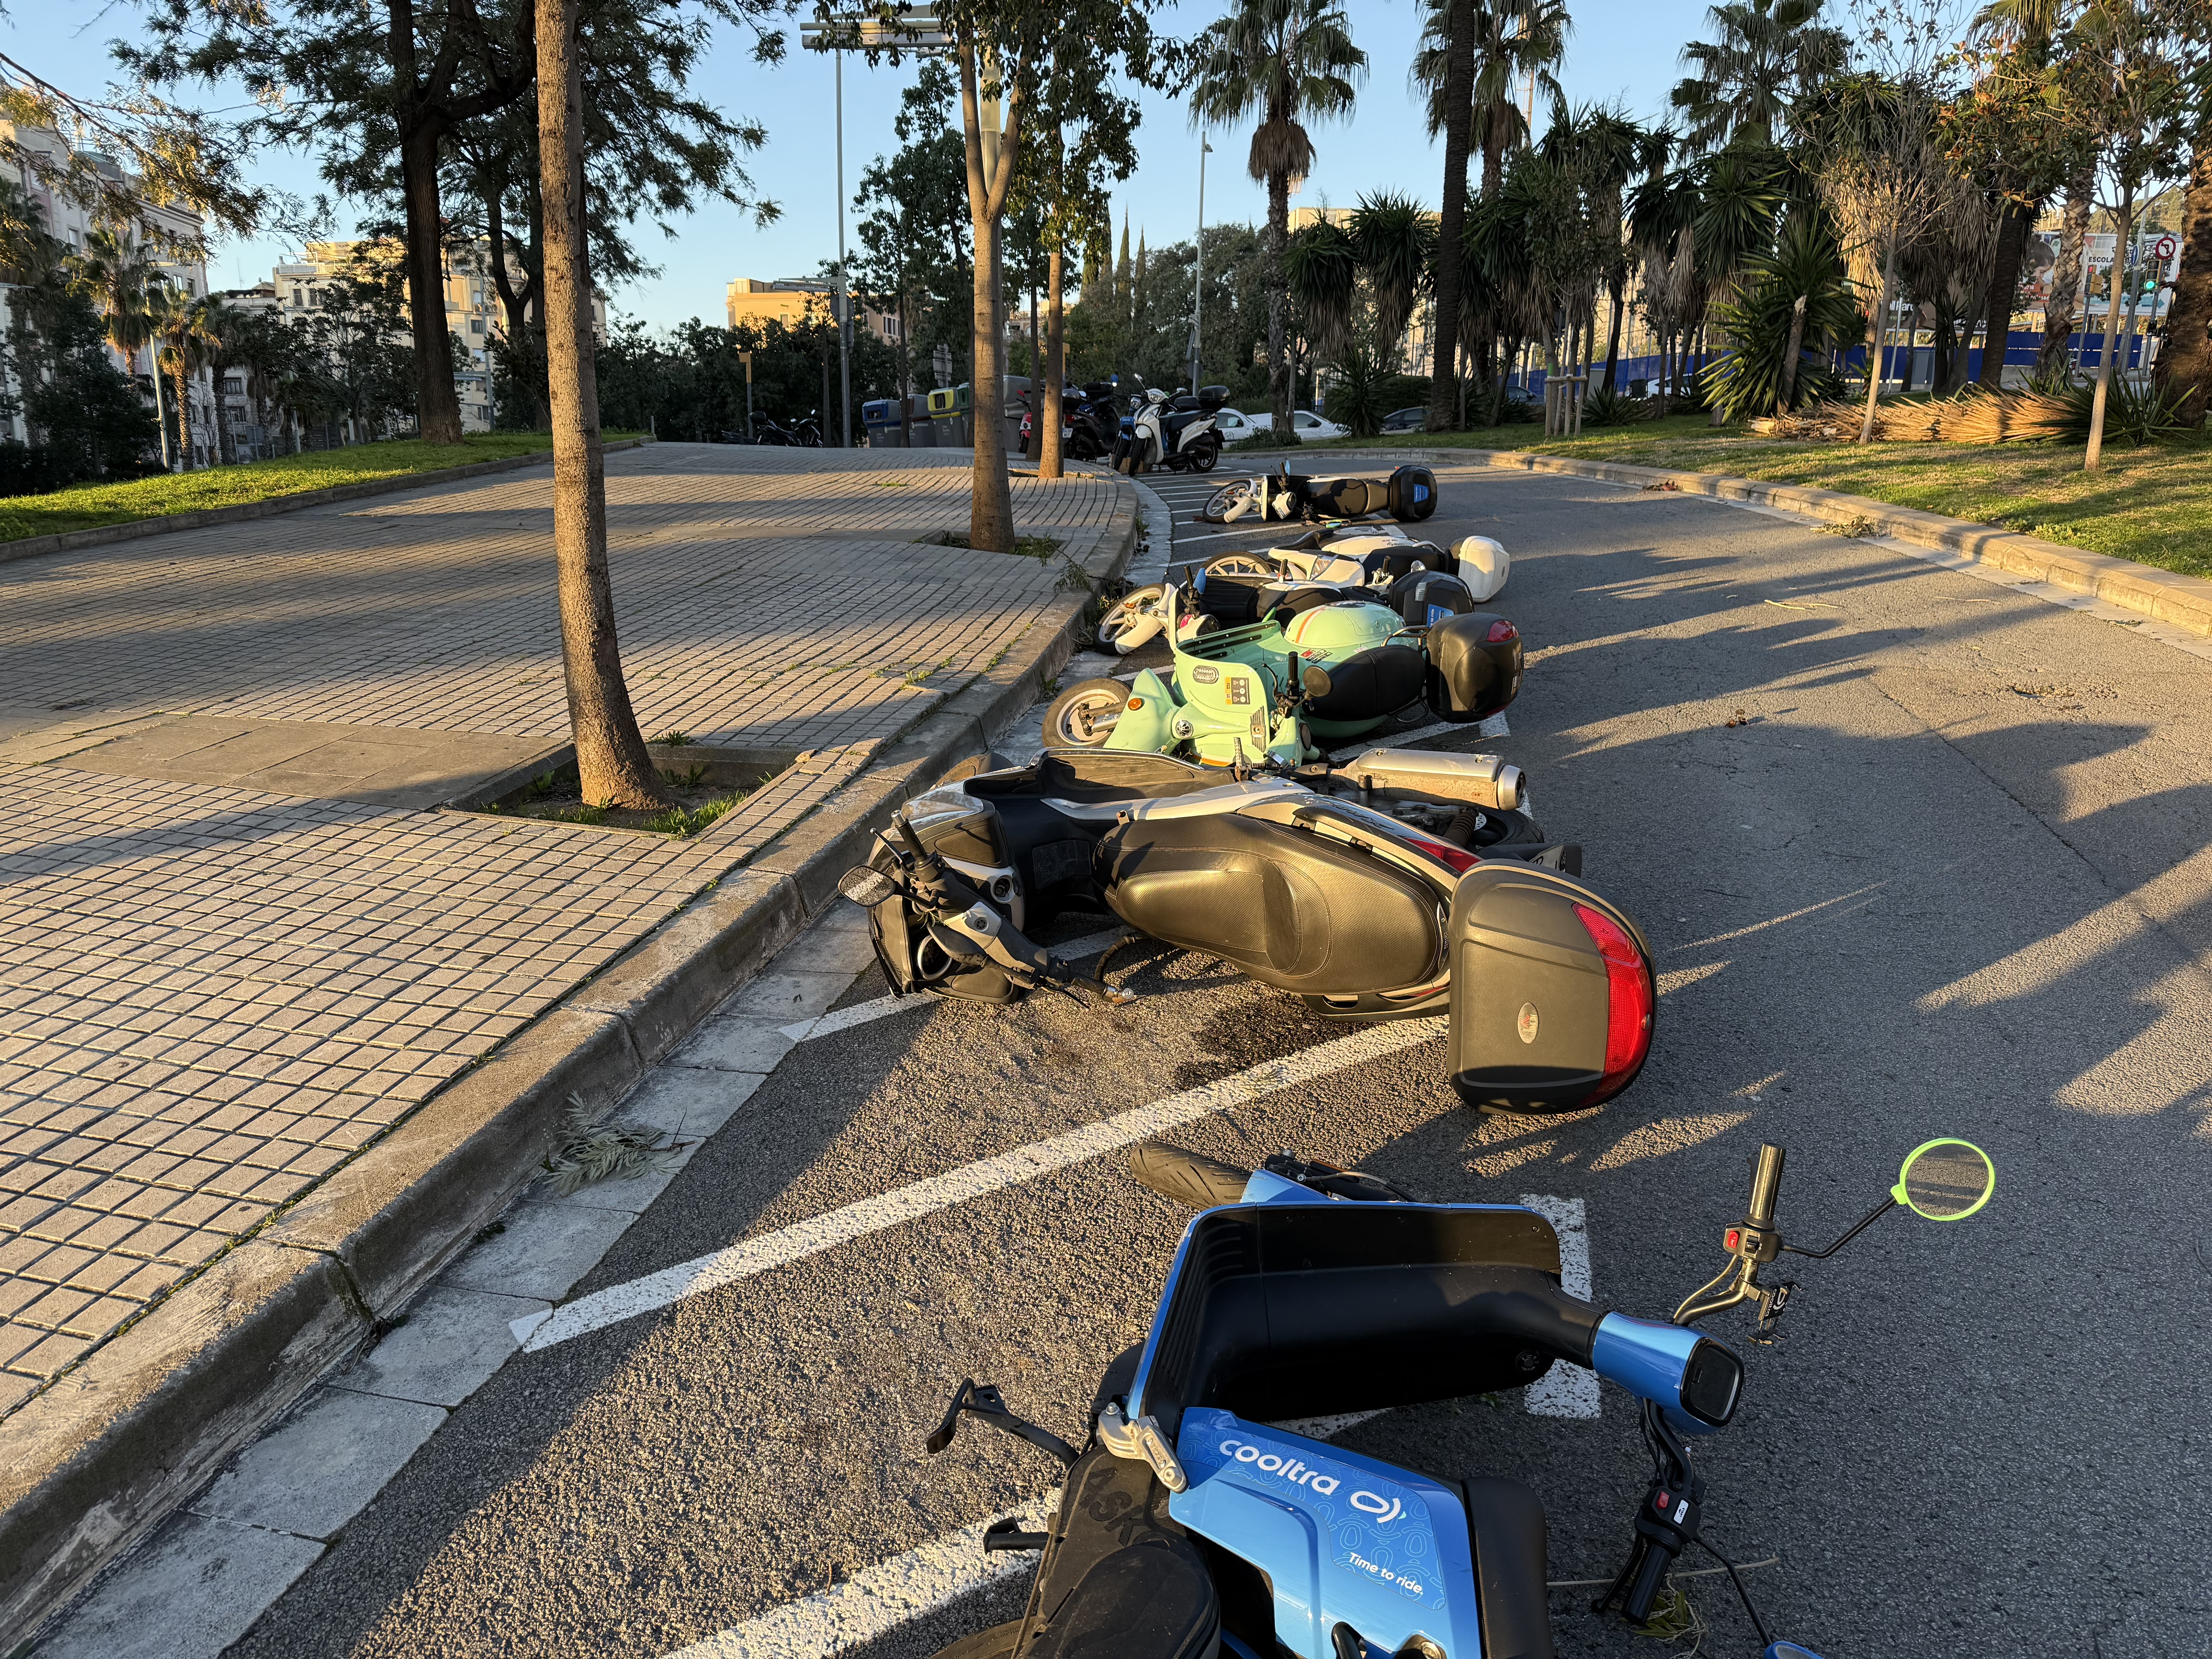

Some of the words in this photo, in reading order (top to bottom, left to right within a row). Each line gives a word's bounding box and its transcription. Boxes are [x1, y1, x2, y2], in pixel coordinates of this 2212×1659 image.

[1765, 1288, 1777, 1317] cooltra
[1219, 1440, 1341, 1496] cooltra
[1349, 1552, 1379, 1573] Time
[1381, 1568, 1394, 1580] to
[1396, 1576, 1424, 1595] ride.
